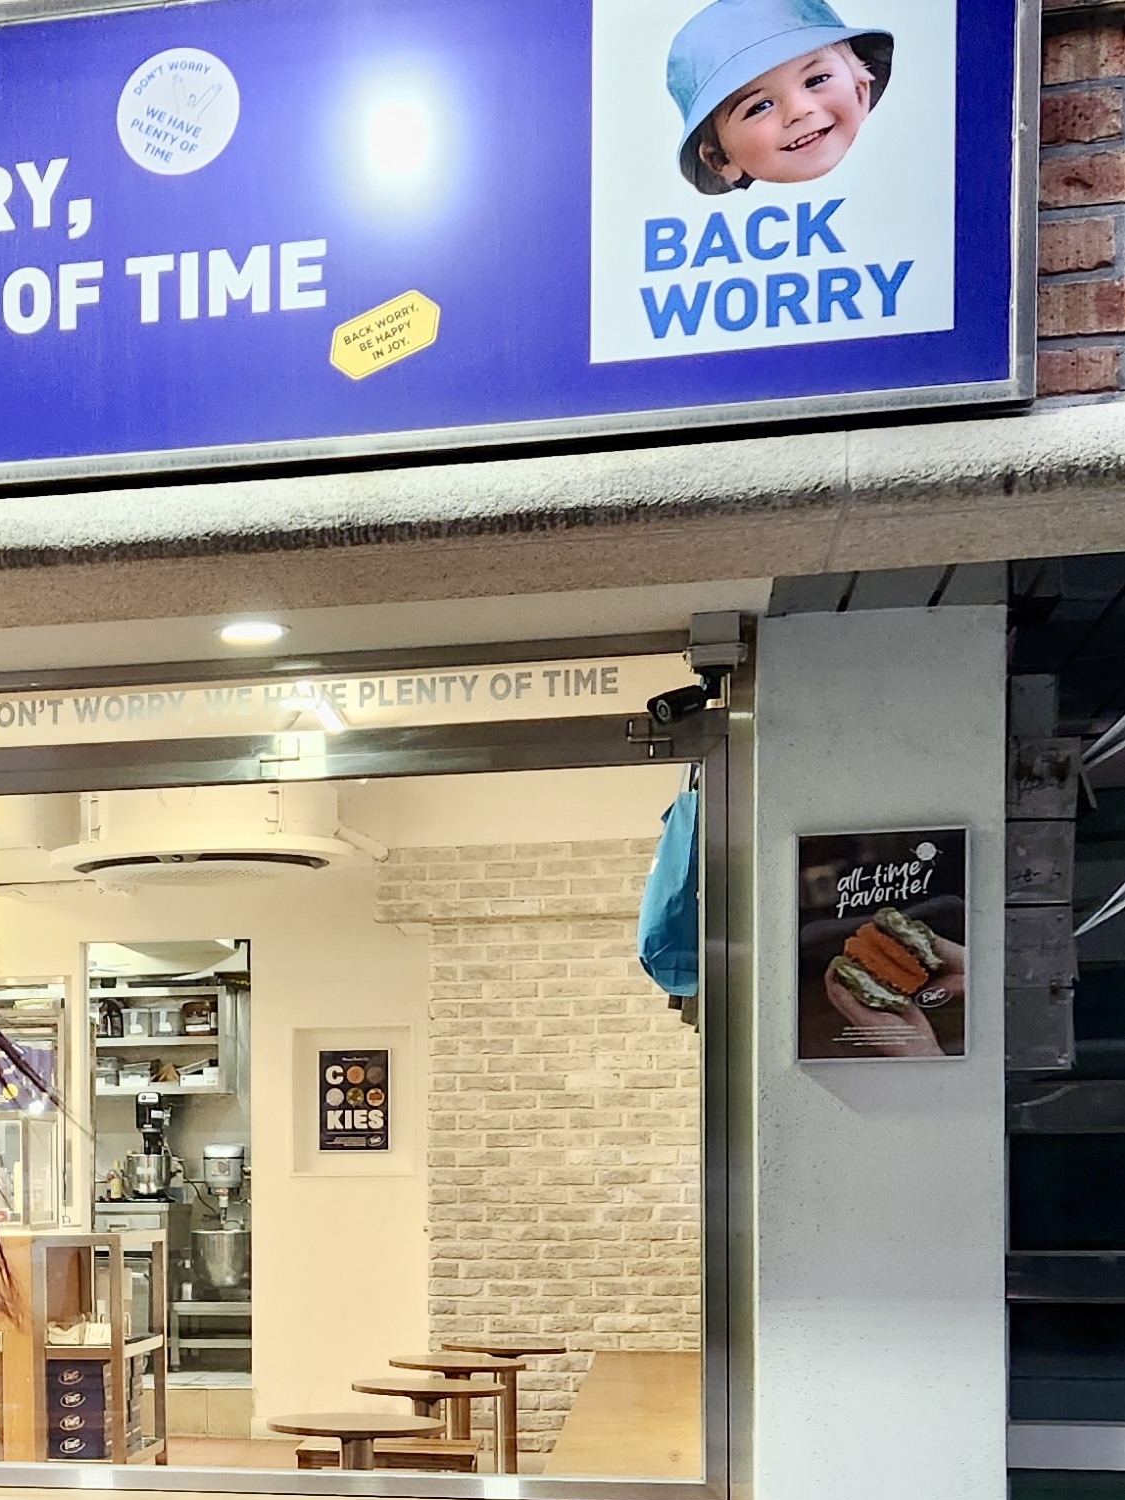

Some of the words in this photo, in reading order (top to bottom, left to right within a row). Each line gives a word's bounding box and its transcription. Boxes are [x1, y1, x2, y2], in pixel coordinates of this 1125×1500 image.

[133, 64, 164, 96] DON'T
[167, 60, 211, 75] WORRY
[130, 118, 179, 146] PLENTY
[179, 140, 199, 154] OF
[145, 105, 167, 123] WE
[167, 115, 203, 139] HAVE
[144, 142, 174, 163] TIME
[643, 198, 847, 273] BACK
[2, 261, 104, 336] OF
[125, 239, 328, 324] TIME
[640, 260, 915, 340] WORRY
[343, 324, 374, 346] BACK
[358, 338, 374, 352] BE
[375, 320, 412, 344] HAPPY
[371, 347, 385, 360] IN
[387, 337, 411, 354] JOY.
[203, 687, 253, 717] WE
[358, 674, 479, 708] PLENTY
[489, 671, 532, 701] OF
[542, 666, 619, 698] TIME
[835, 868, 934, 919] favorite!
[836, 859, 921, 892] all-time
